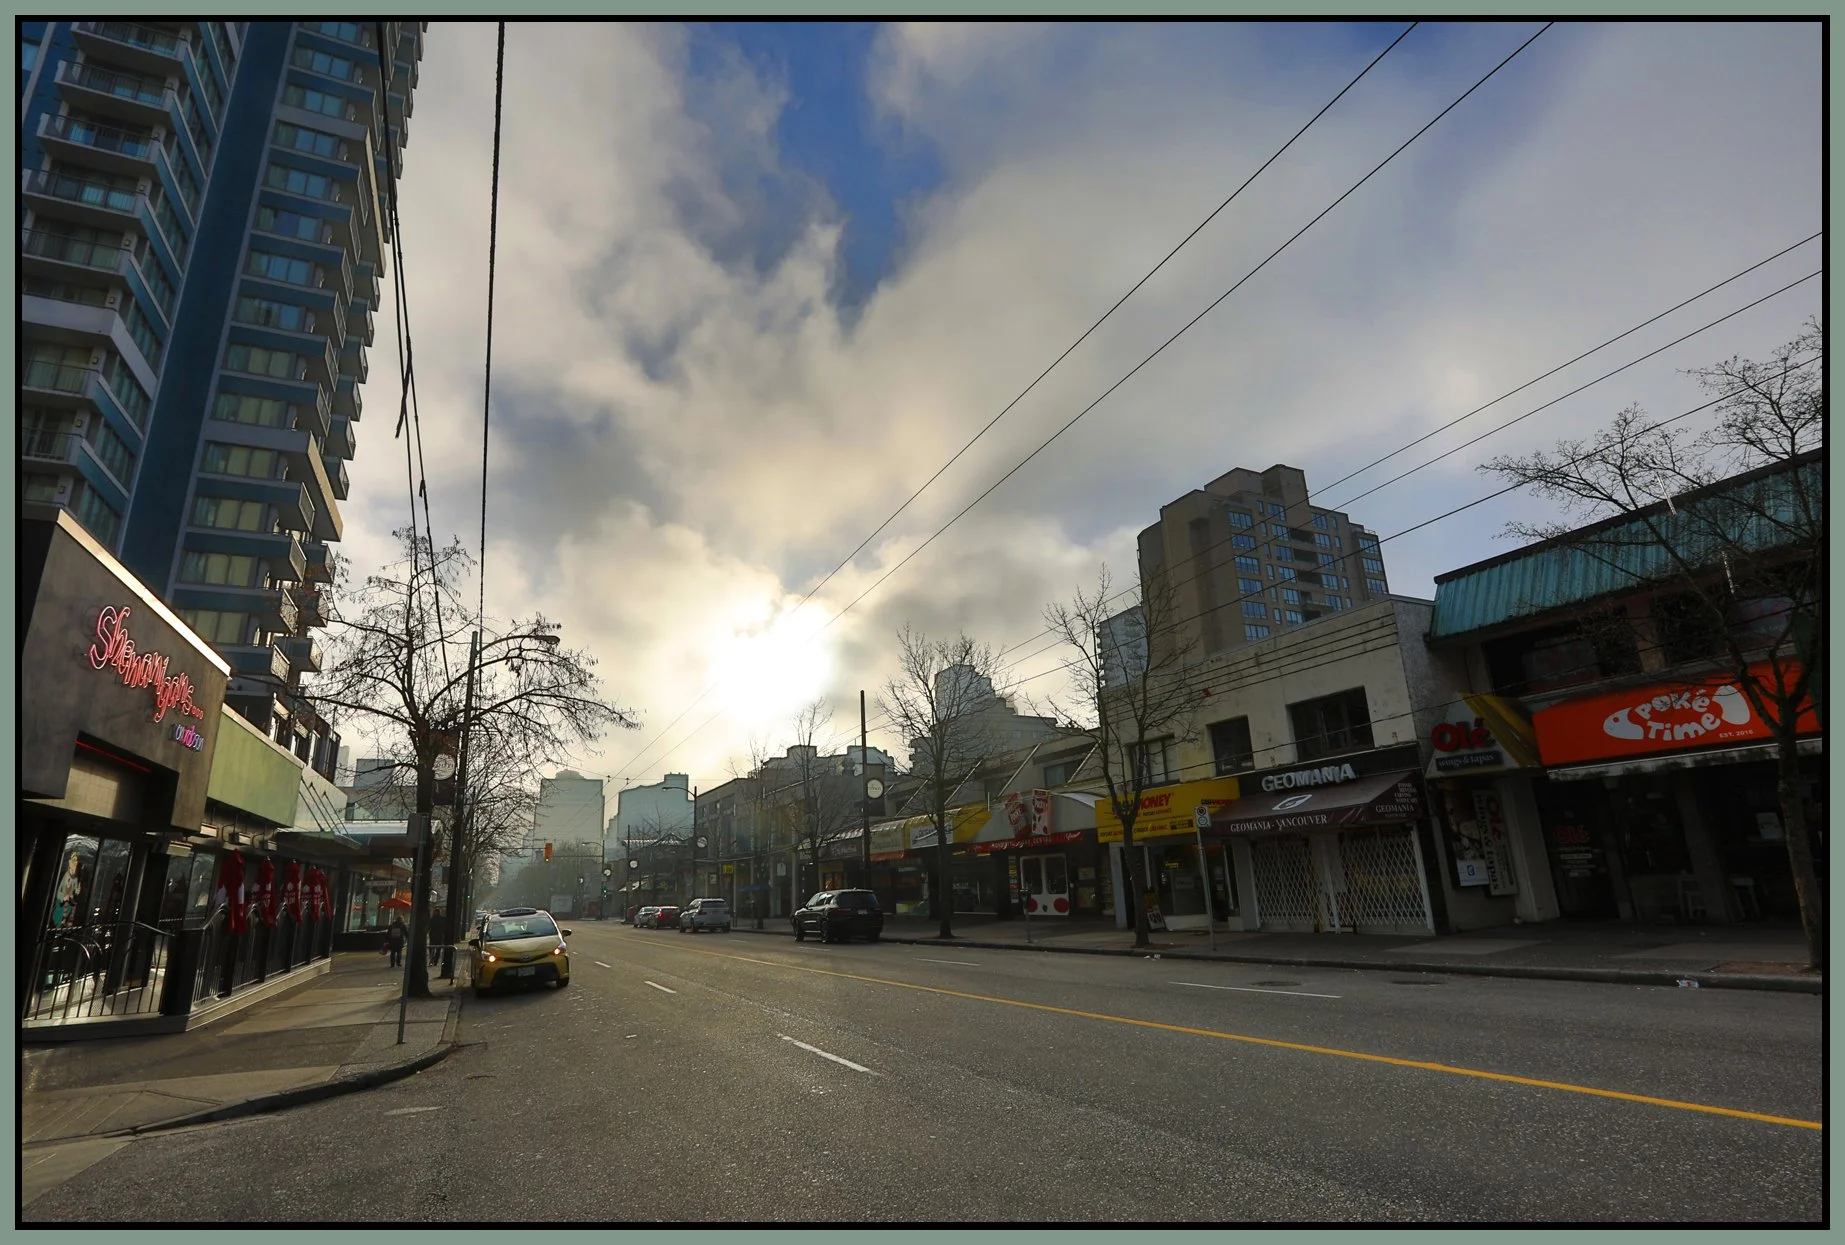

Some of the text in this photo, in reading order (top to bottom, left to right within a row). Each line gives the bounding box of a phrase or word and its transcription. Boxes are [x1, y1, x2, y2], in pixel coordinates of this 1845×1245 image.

[1431, 718, 1490, 752] Olé
[1647, 712, 1721, 741] Time
[1262, 764, 1357, 792] GEOMANIA
[1375, 804, 1416, 813] GEOMANIA
[1230, 820, 1271, 833] GEOMANIA
[1276, 814, 1327, 830] VANCOUVER
